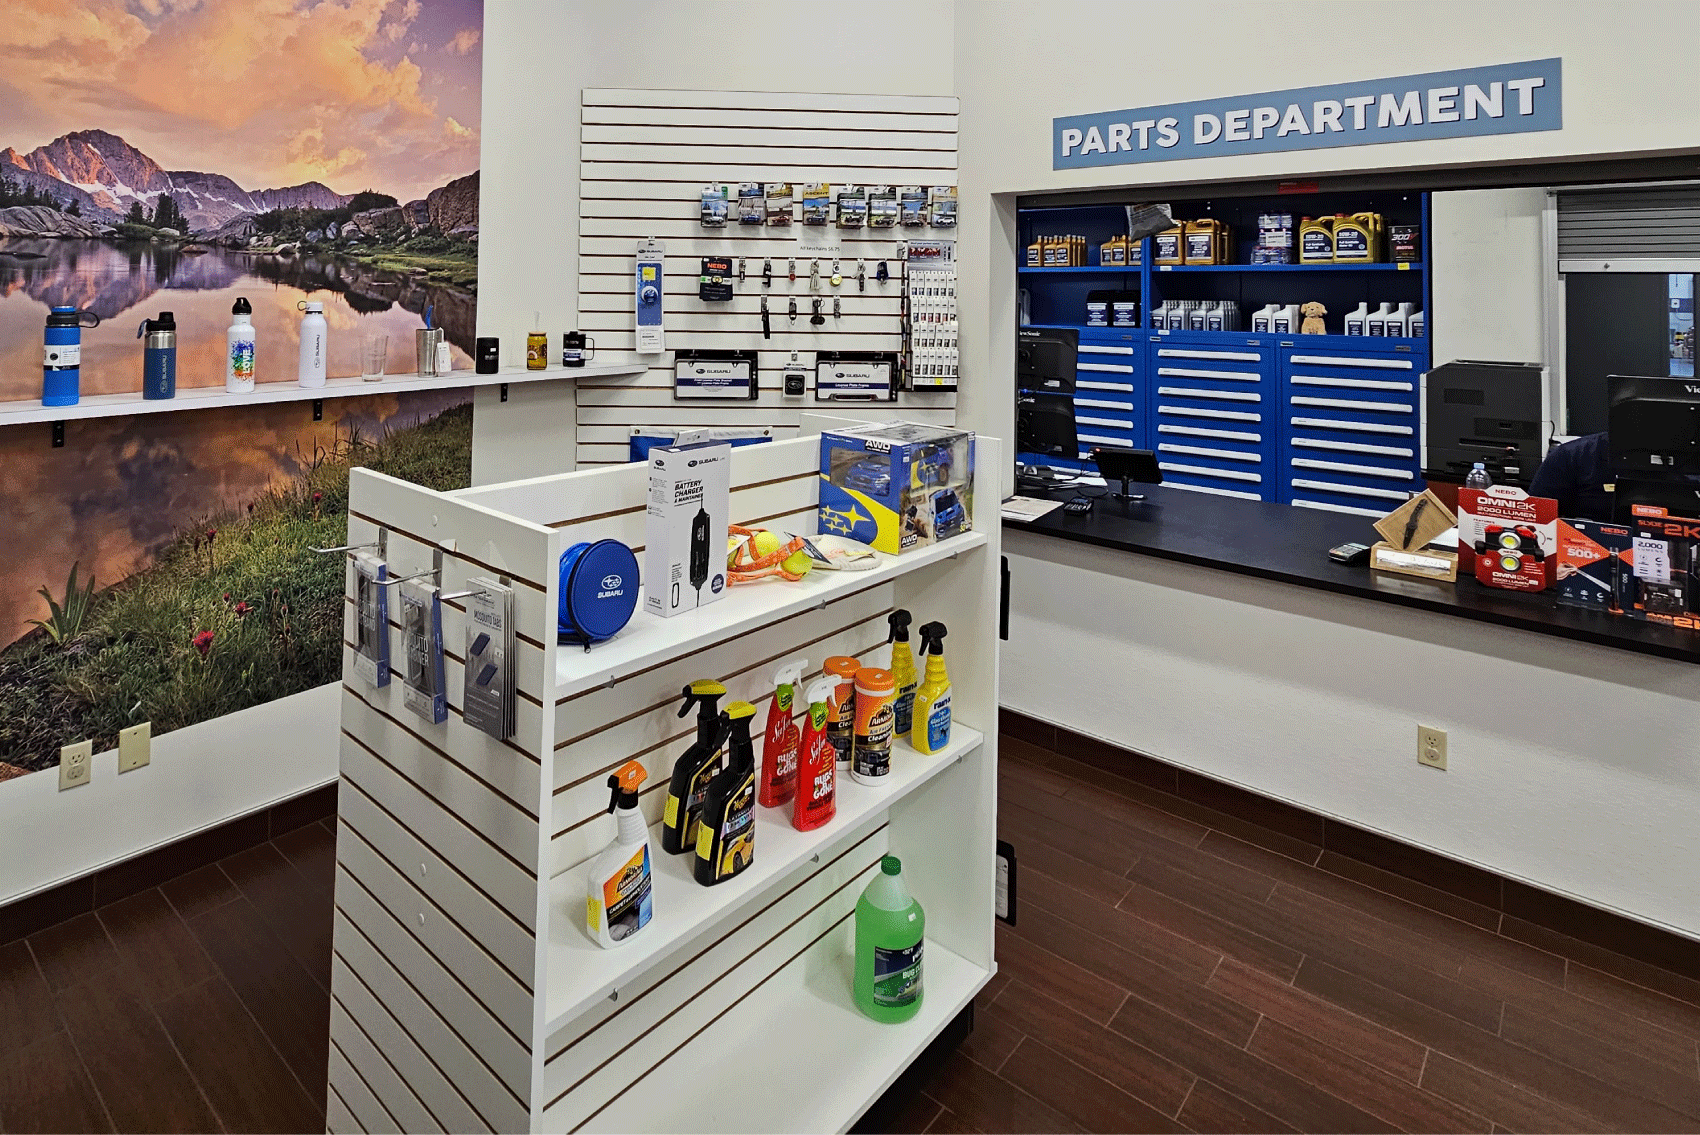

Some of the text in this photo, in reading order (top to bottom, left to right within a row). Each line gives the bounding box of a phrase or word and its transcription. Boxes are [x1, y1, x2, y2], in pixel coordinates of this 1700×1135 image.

[1061, 76, 1547, 157] PARTS DEPARTMENT
[1391, 232, 1420, 241] 300V
[707, 262, 727, 270] NEBO
[242, 349, 251, 374] LOVE
[865, 439, 891, 451] AWD
[698, 456, 719, 465] SUBARU
[674, 479, 703, 491] BATTERY
[674, 485, 704, 498] CHARGER
[1495, 488, 1517, 496] NEBO
[1476, 505, 1537, 519] 2000 LUMEN
[1636, 507, 1663, 515] NEBO
[1600, 526, 1628, 535] NEBO
[1664, 523, 1700, 540] 2K
[901, 533, 918, 546] AWD
[1567, 547, 1601, 559] 500+
[597, 589, 624, 599] SUBARU
[474, 609, 492, 625] MOSQUITO
[492, 616, 502, 629] TABS
[776, 761, 798, 776] GONE
[813, 782, 833, 800] GONE
[902, 968, 915, 979] BUG
